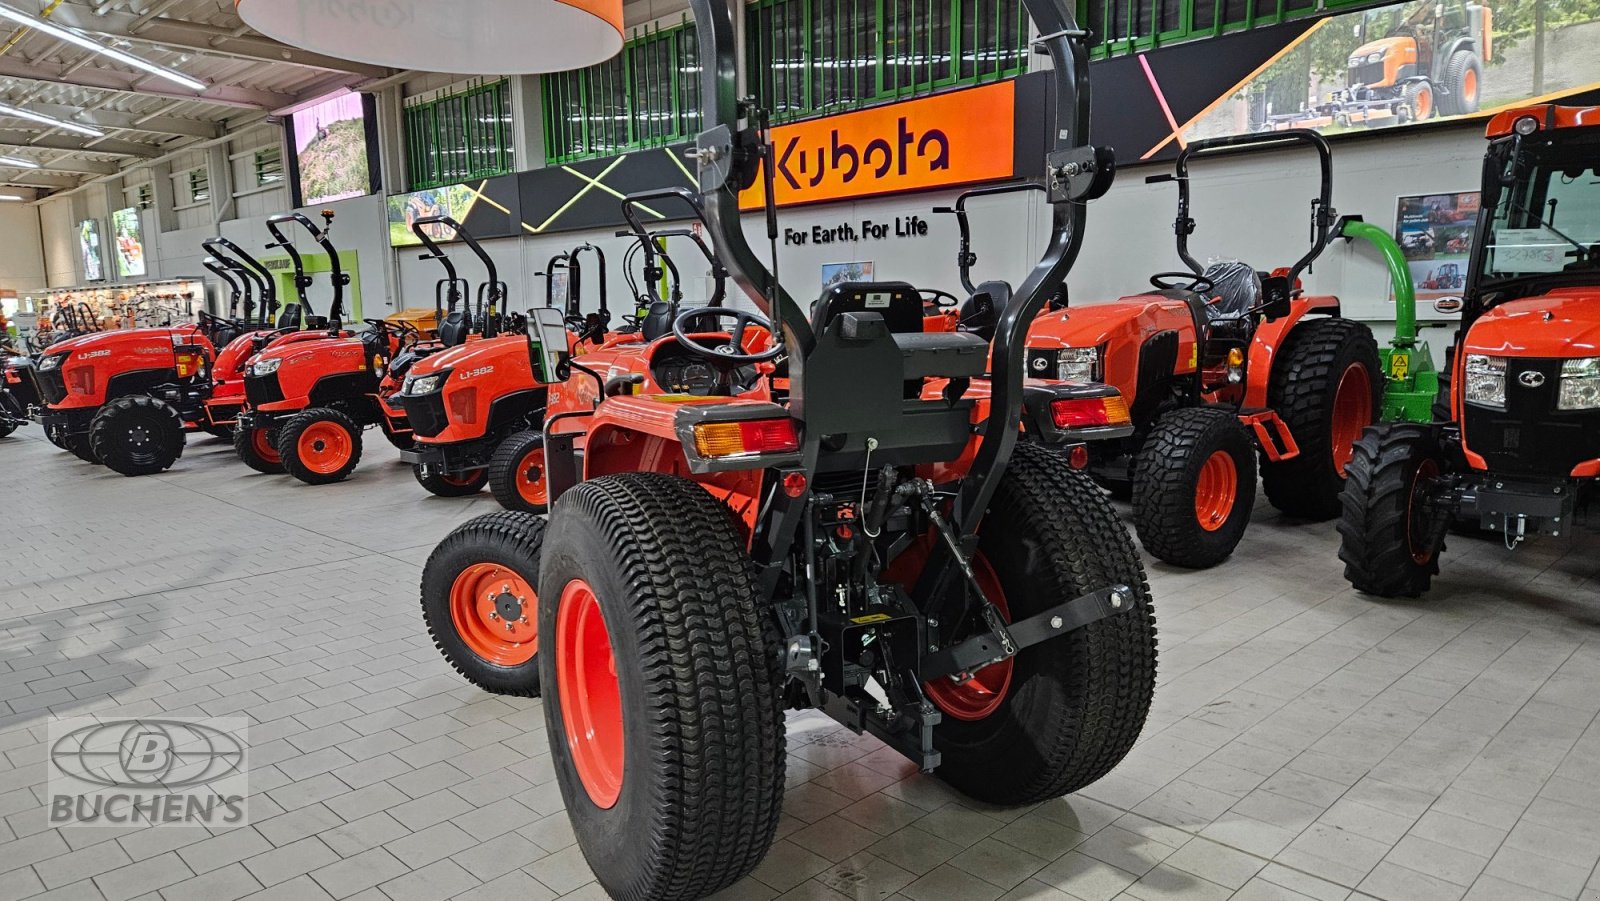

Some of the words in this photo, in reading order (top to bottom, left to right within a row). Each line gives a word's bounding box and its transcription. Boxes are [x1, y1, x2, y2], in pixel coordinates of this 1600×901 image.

[771, 116, 949, 189] Kubota
[784, 228, 808, 246] For
[812, 222, 858, 244] Earth,
[862, 220, 889, 239] For
[895, 216, 928, 237] Life
[459, 365, 495, 380] L1-382
